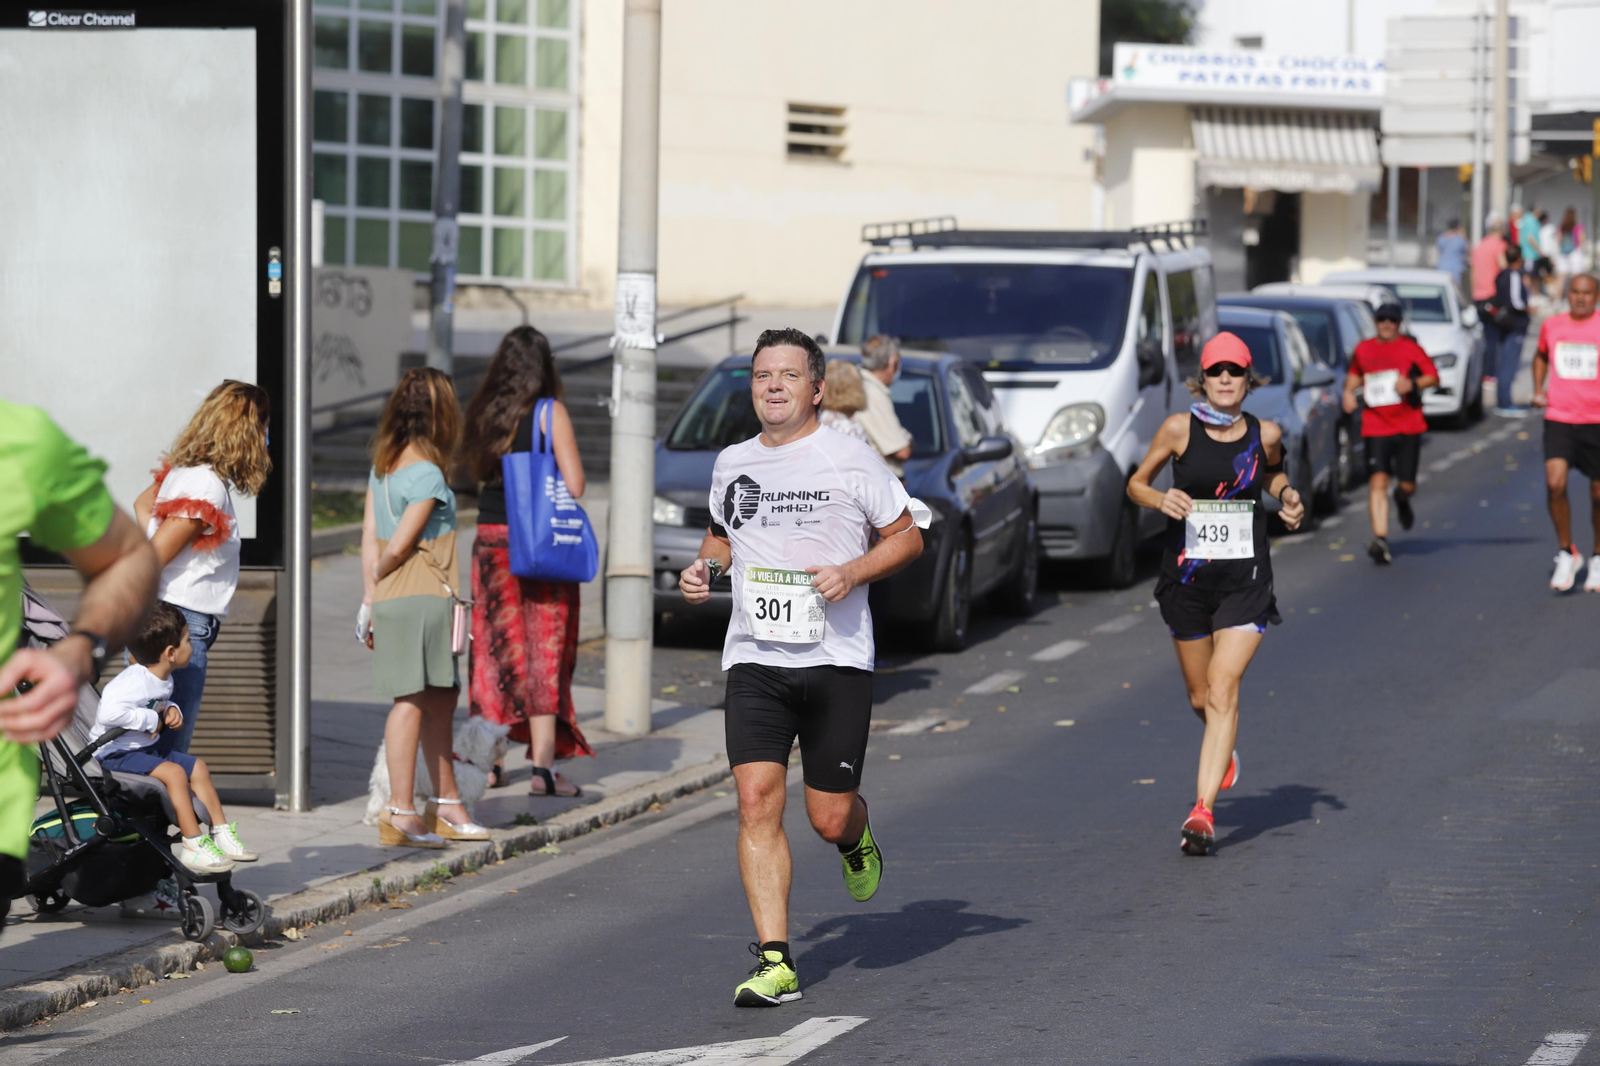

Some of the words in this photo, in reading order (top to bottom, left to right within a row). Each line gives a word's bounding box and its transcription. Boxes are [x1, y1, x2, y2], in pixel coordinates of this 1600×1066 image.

[48, 12, 82, 26] Clear
[83, 12, 136, 26] Channel
[1147, 50, 1257, 68] CHURROS
[1179, 69, 1284, 87] PATATAS
[1290, 74, 1372, 91] FRITAS
[761, 490, 830, 502] RUNNING
[771, 503, 813, 513] MMH21
[1199, 503, 1220, 513] VUELTA
[1221, 503, 1227, 513] A
[1227, 503, 1249, 513] HUELVA
[1197, 524, 1229, 543] 439
[757, 571, 784, 583] VUELTA
[785, 573, 792, 584] A
[755, 596, 792, 623] 301
